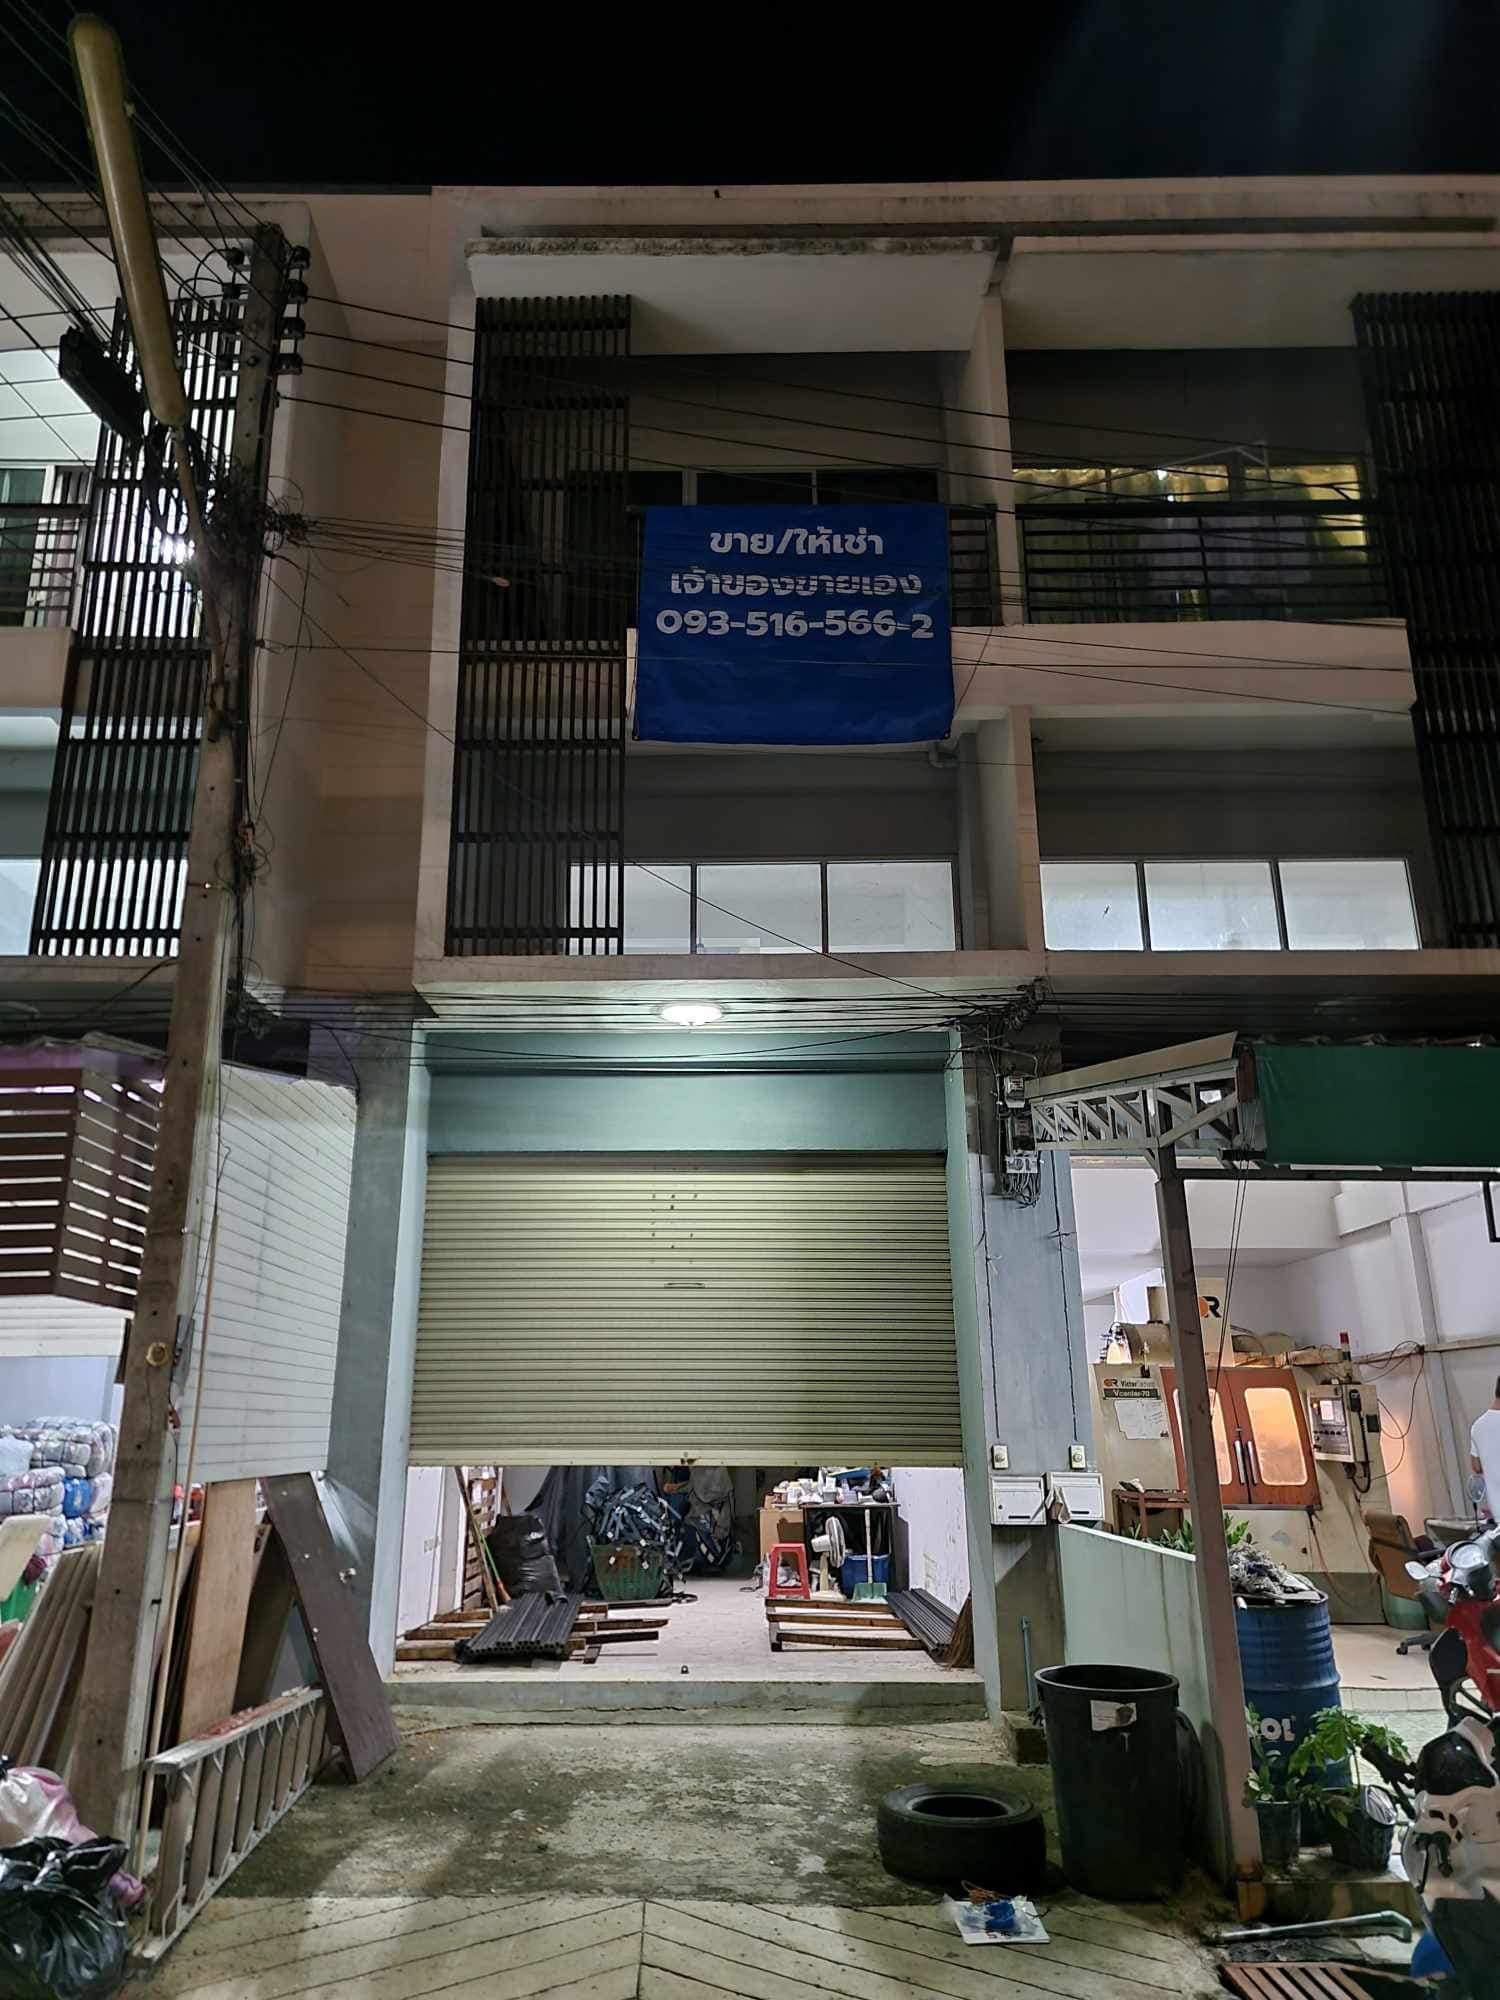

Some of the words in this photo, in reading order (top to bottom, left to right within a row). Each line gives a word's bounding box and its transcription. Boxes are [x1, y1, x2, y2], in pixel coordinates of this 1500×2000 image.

[709, 525, 884, 555] ขาย/ให้เช่า
[671, 566, 922, 597] เจ้าของขายเอง
[655, 609, 935, 640] 093-516-566-2
